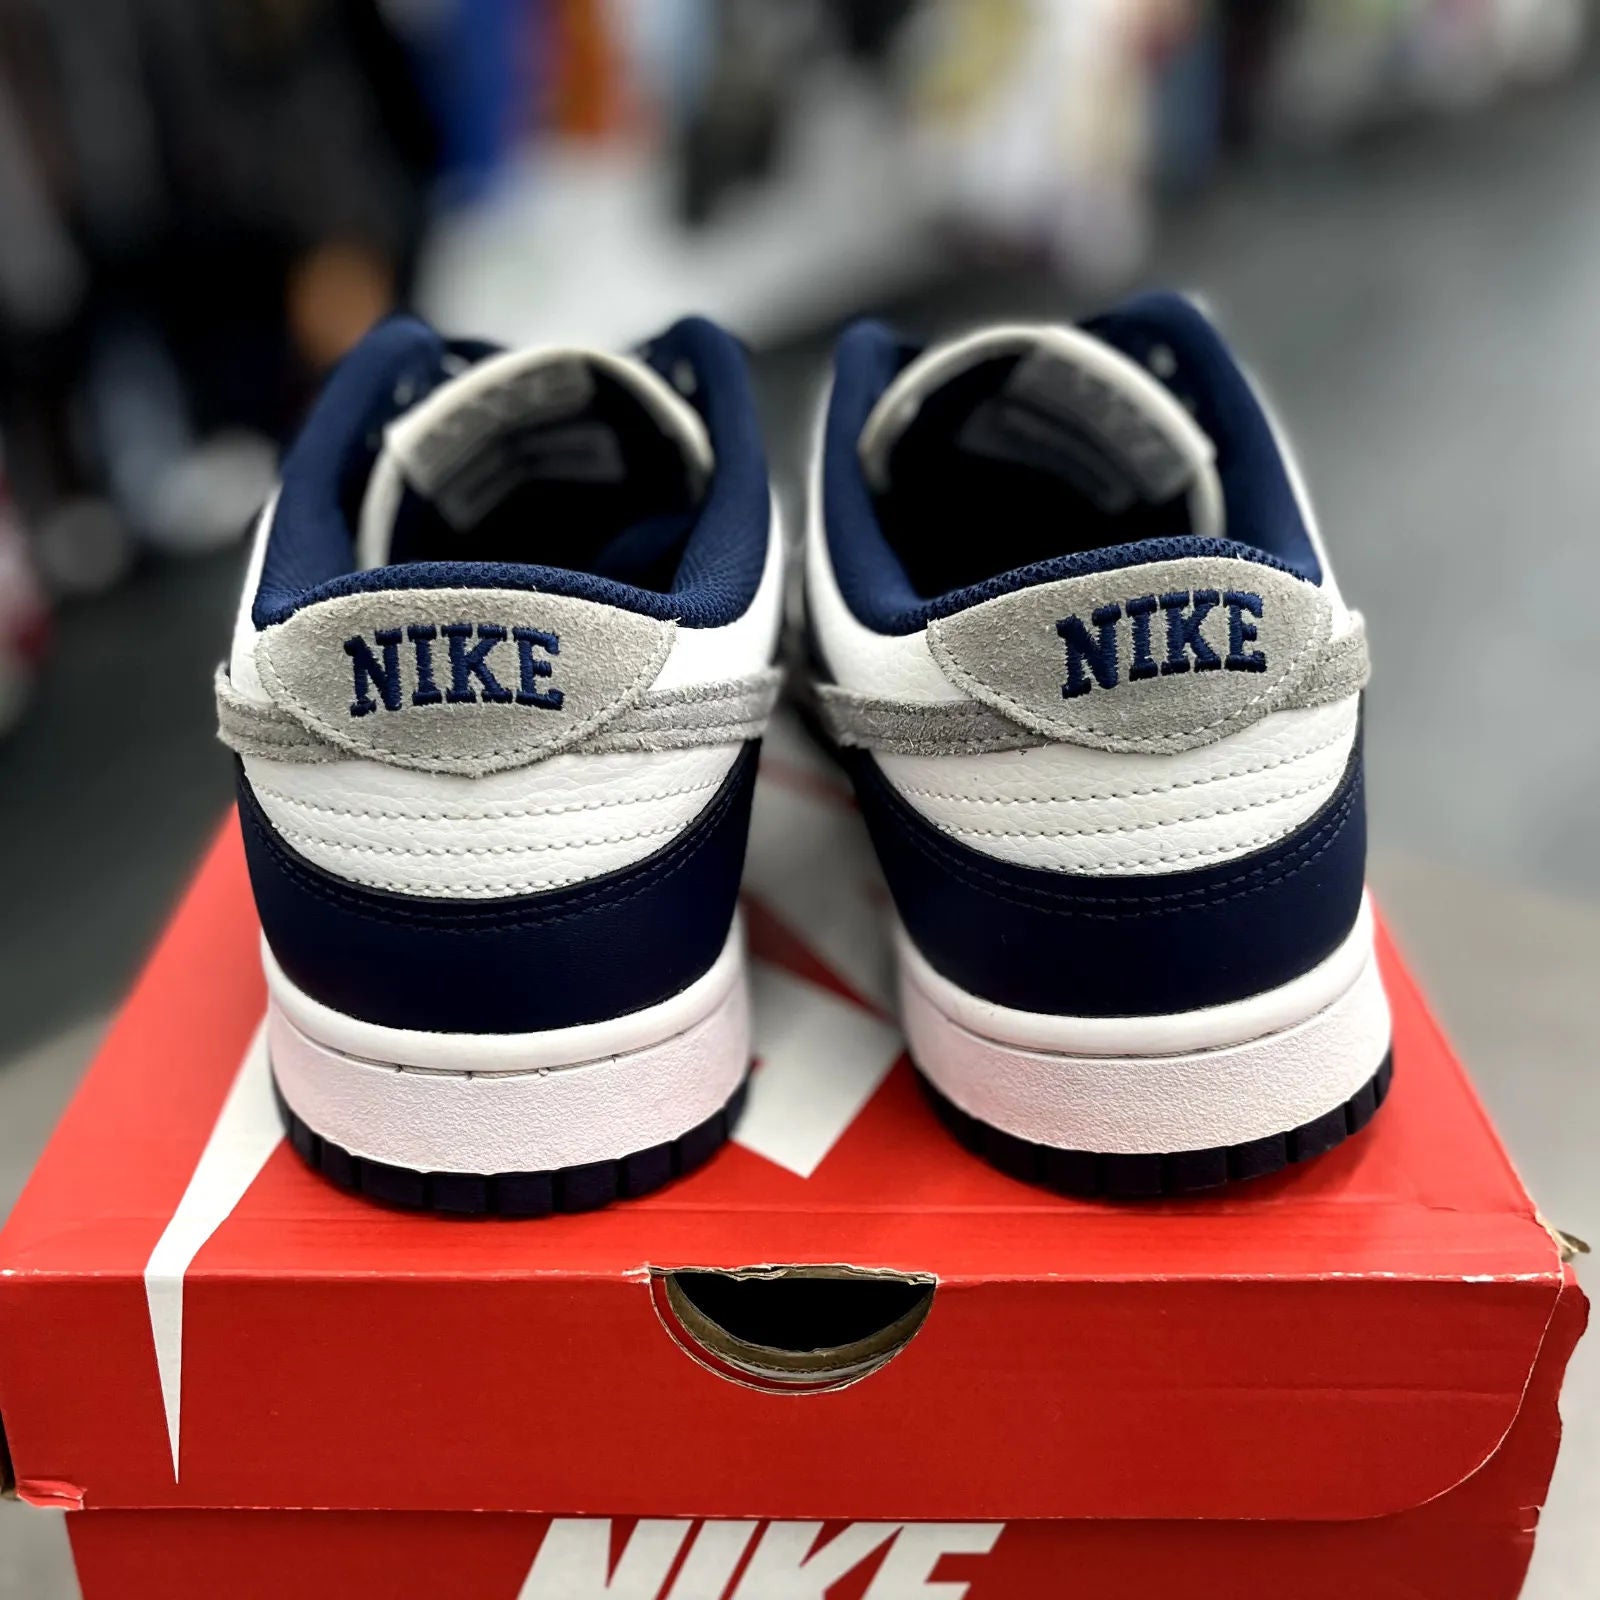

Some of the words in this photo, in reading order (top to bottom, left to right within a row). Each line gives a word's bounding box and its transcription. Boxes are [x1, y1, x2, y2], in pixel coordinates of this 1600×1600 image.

[344, 623, 565, 717] NIKE
[1056, 589, 1267, 699] NIKE
[516, 1518, 1006, 1600] NIKE
